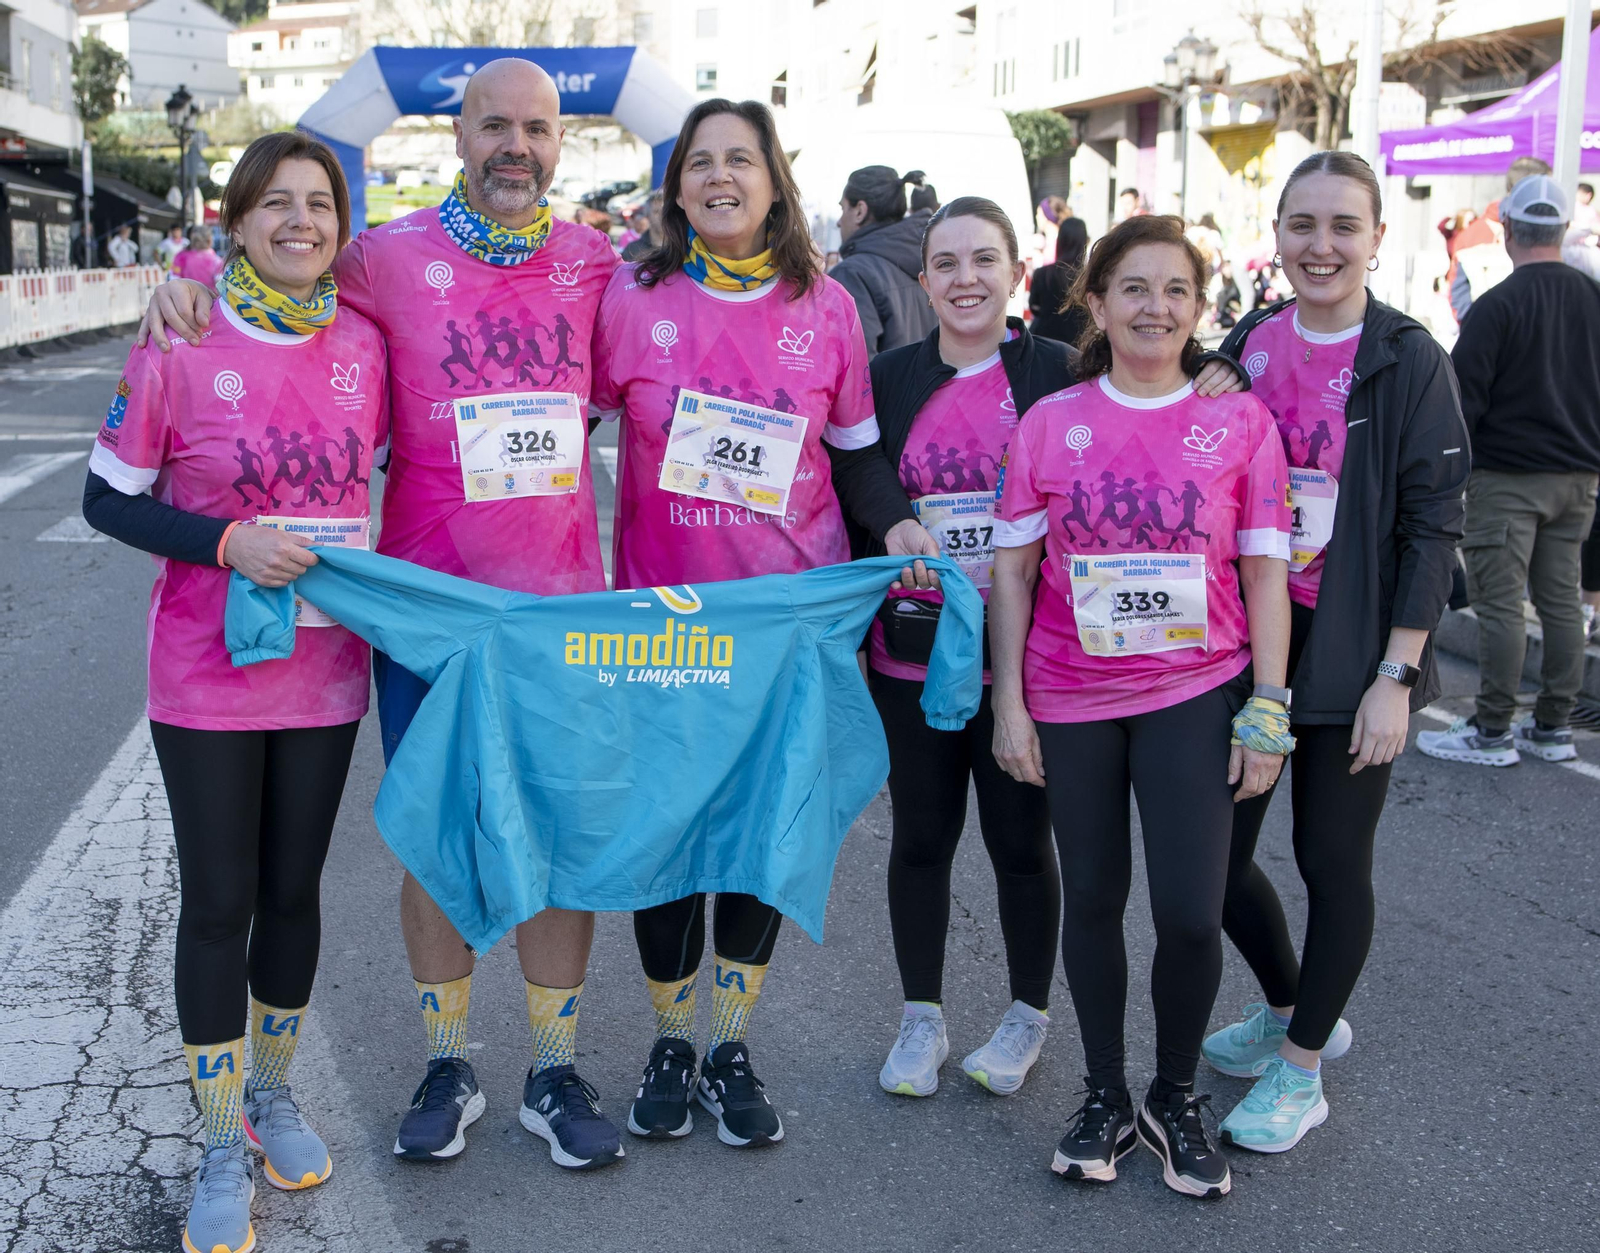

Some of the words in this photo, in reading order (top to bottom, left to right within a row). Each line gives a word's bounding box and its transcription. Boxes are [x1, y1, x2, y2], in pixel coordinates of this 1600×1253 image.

[170, 331, 212, 346] TEAGY
[481, 400, 515, 410] CARREIRA
[517, 399, 534, 408] POLA
[535, 398, 568, 407] IGUALDADE
[512, 407, 547, 416] BARBADÁS
[681, 396, 699, 414] III
[460, 404, 477, 420] III
[704, 401, 737, 414] CARREIRA
[738, 408, 755, 419] POLA
[757, 411, 794, 428] IGUALDADE
[730, 416, 766, 431] BARBADÁS
[506, 430, 556, 454] 326
[714, 437, 762, 467] 261
[706, 458, 717, 466] OLGA
[717, 460, 738, 471] FERREIRO
[1292, 474, 1327, 484] IGUALDADE
[925, 500, 955, 508] CARREIRA
[957, 498, 974, 506] POLA
[976, 496, 995, 504] IGUAL
[952, 505, 988, 515] BARBADÁS
[284, 524, 319, 533] CARREIRA
[321, 525, 337, 533] POLA
[947, 526, 994, 550] 337
[1094, 560, 1128, 569] CARREIRA
[1129, 559, 1148, 567] POLA
[1150, 559, 1191, 568] IGUALDADE
[1123, 568, 1162, 577] BARBADÁS
[1116, 591, 1169, 613] 339
[565, 618, 734, 667] amodiño
[598, 669, 618, 687] by
[626, 669, 730, 688] LIMIACTIVA
[262, 1014, 300, 1037] LA
[197, 1052, 234, 1080] LA
